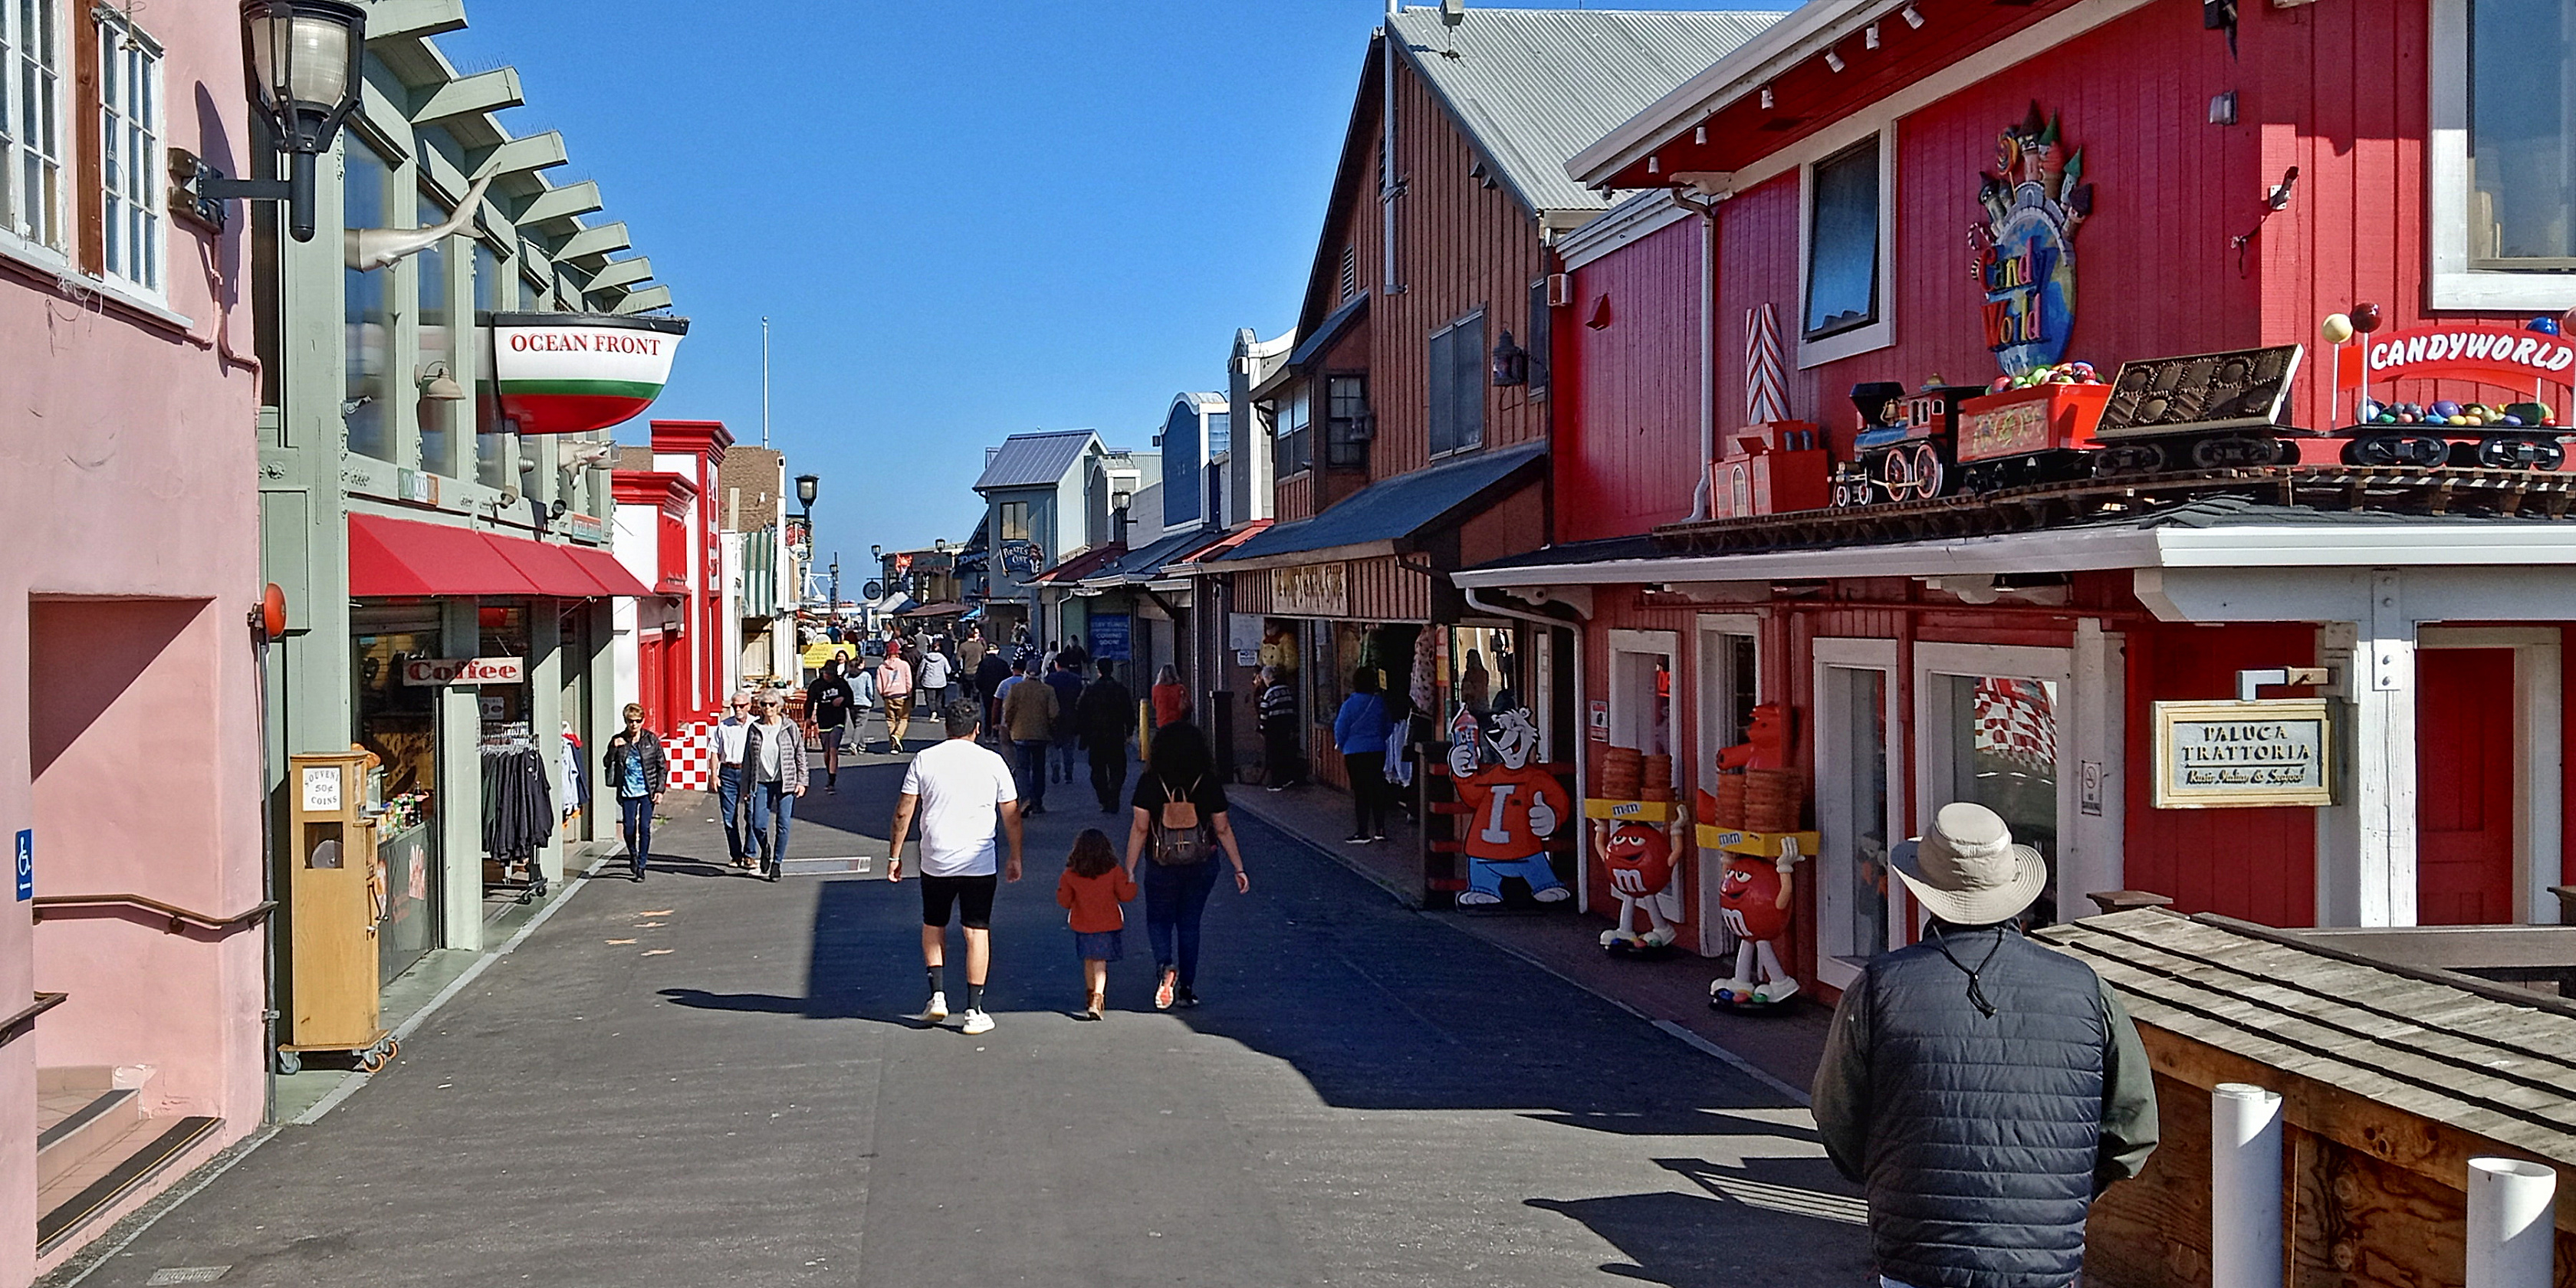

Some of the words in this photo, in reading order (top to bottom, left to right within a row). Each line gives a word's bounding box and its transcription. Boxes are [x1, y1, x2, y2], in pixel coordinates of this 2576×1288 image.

[1979, 236, 2049, 295] Candy
[1981, 293, 2042, 347] World
[510, 333, 588, 352] OCEAN
[593, 334, 661, 356] FRONT
[2370, 333, 2574, 372] CANDYWORLD
[409, 661, 518, 681] Coffee
[2201, 725, 2288, 742] PALUCA
[2182, 744, 2310, 761] TRATTORIA
[2250, 769, 2264, 784] &
[315, 784, 334, 793] 50¢
[311, 795, 337, 806] COINS
